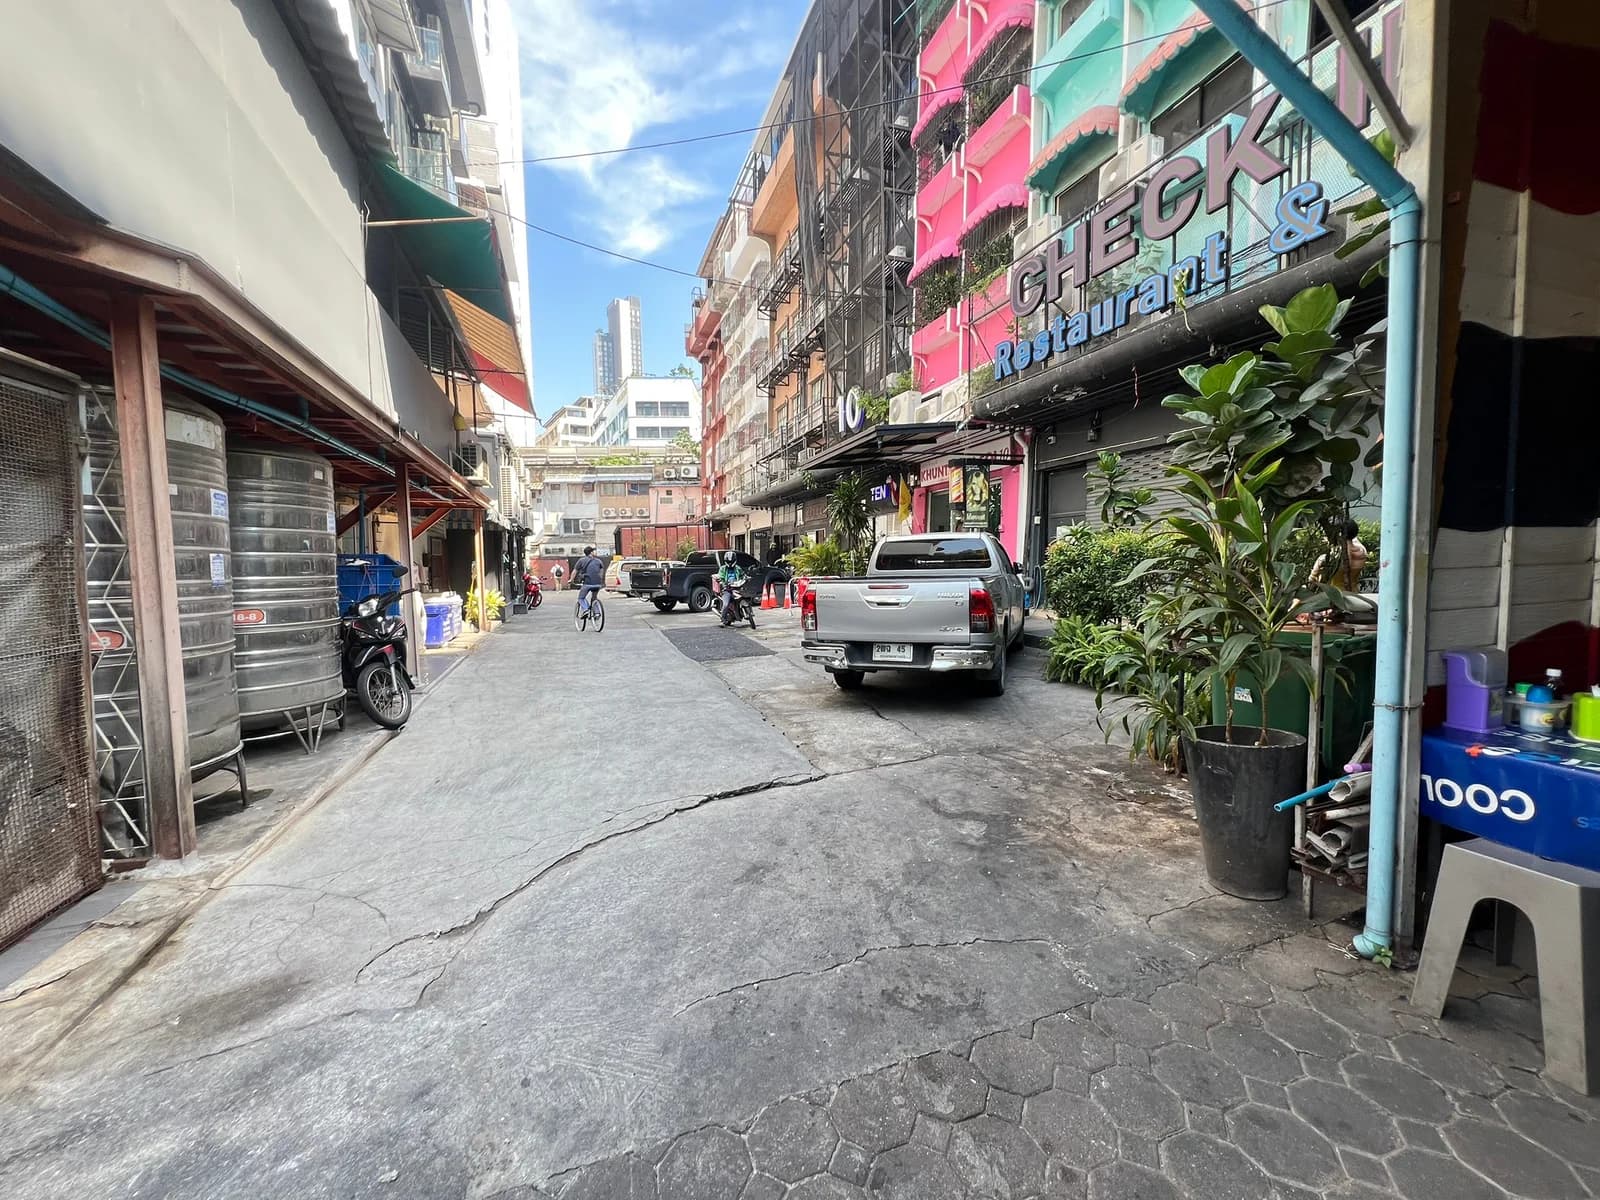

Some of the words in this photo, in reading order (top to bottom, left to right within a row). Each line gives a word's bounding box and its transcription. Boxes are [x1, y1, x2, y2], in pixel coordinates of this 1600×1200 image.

[1009, 92, 1290, 317] CHECK
[994, 231, 1226, 381] Restaurant
[1268, 181, 1331, 253] &
[838, 387, 862, 433] 10
[870, 484, 887, 501] TEN
[1421, 774, 1536, 822] COOL
